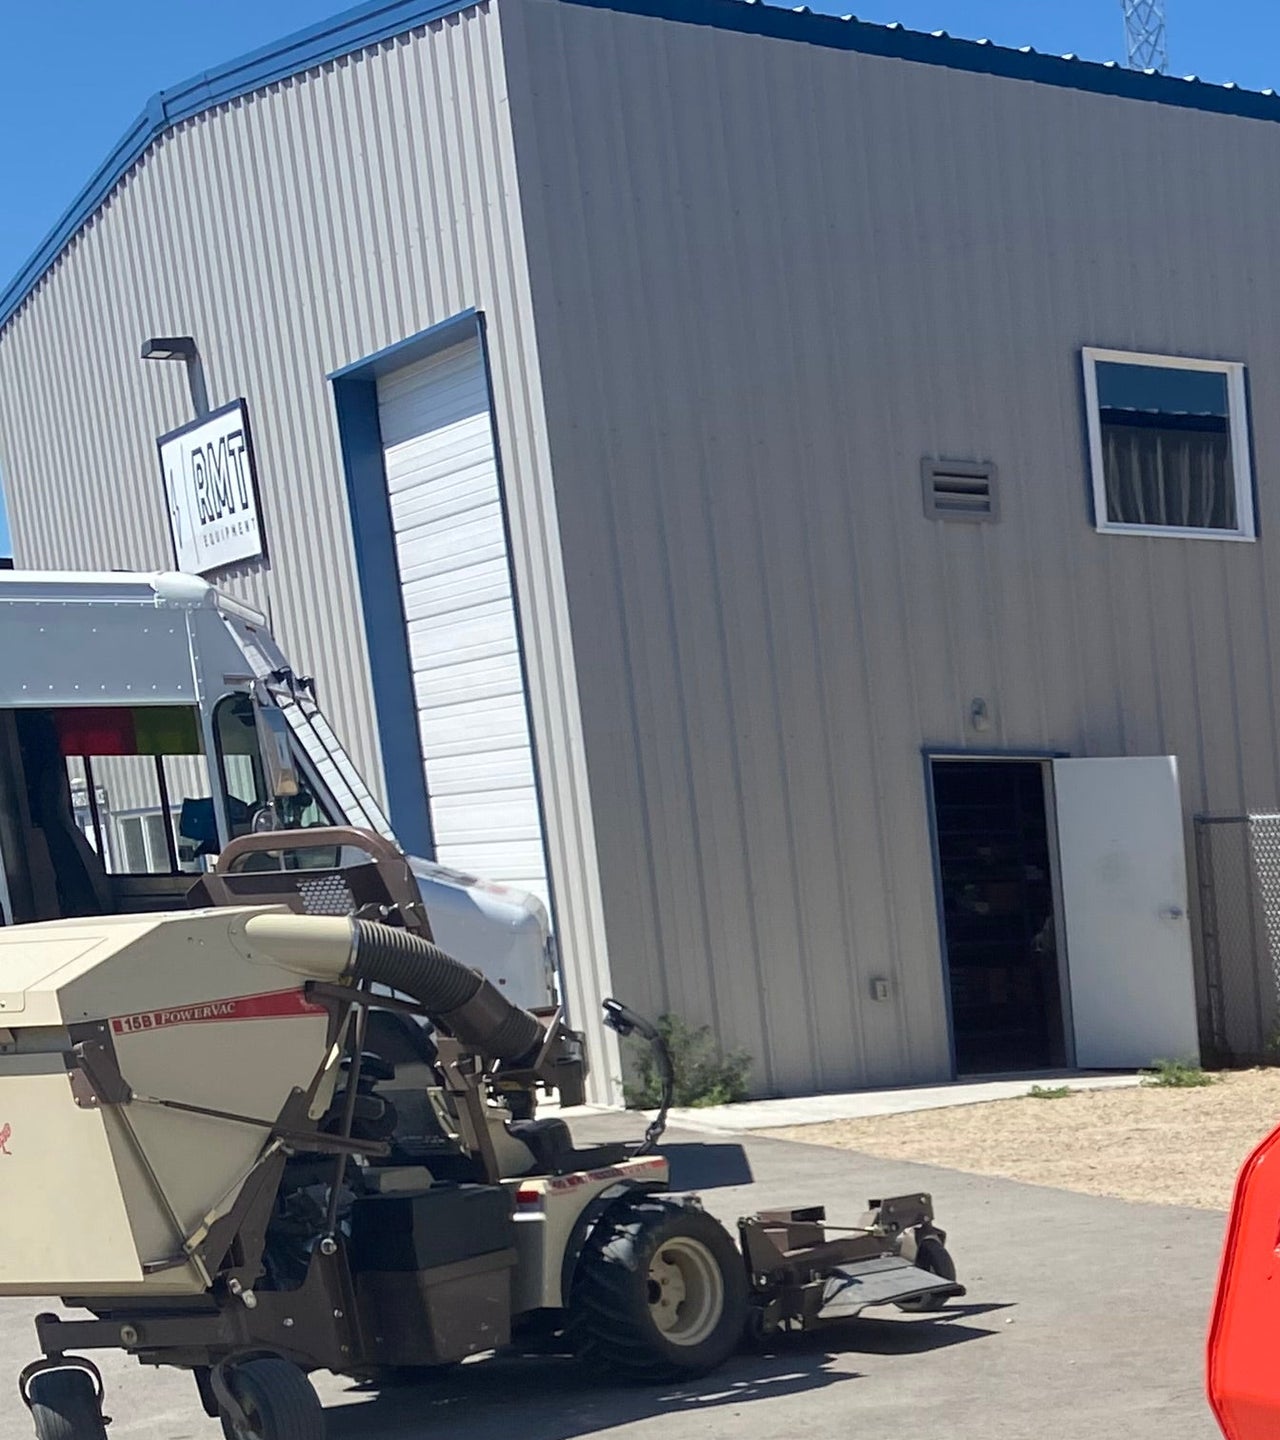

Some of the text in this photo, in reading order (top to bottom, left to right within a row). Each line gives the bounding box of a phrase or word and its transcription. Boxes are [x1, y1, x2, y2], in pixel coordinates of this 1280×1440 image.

[191, 429, 249, 526] RMT
[203, 518, 257, 548] EQUIPMENT
[123, 1002, 236, 1031] 15B POWERVAC
